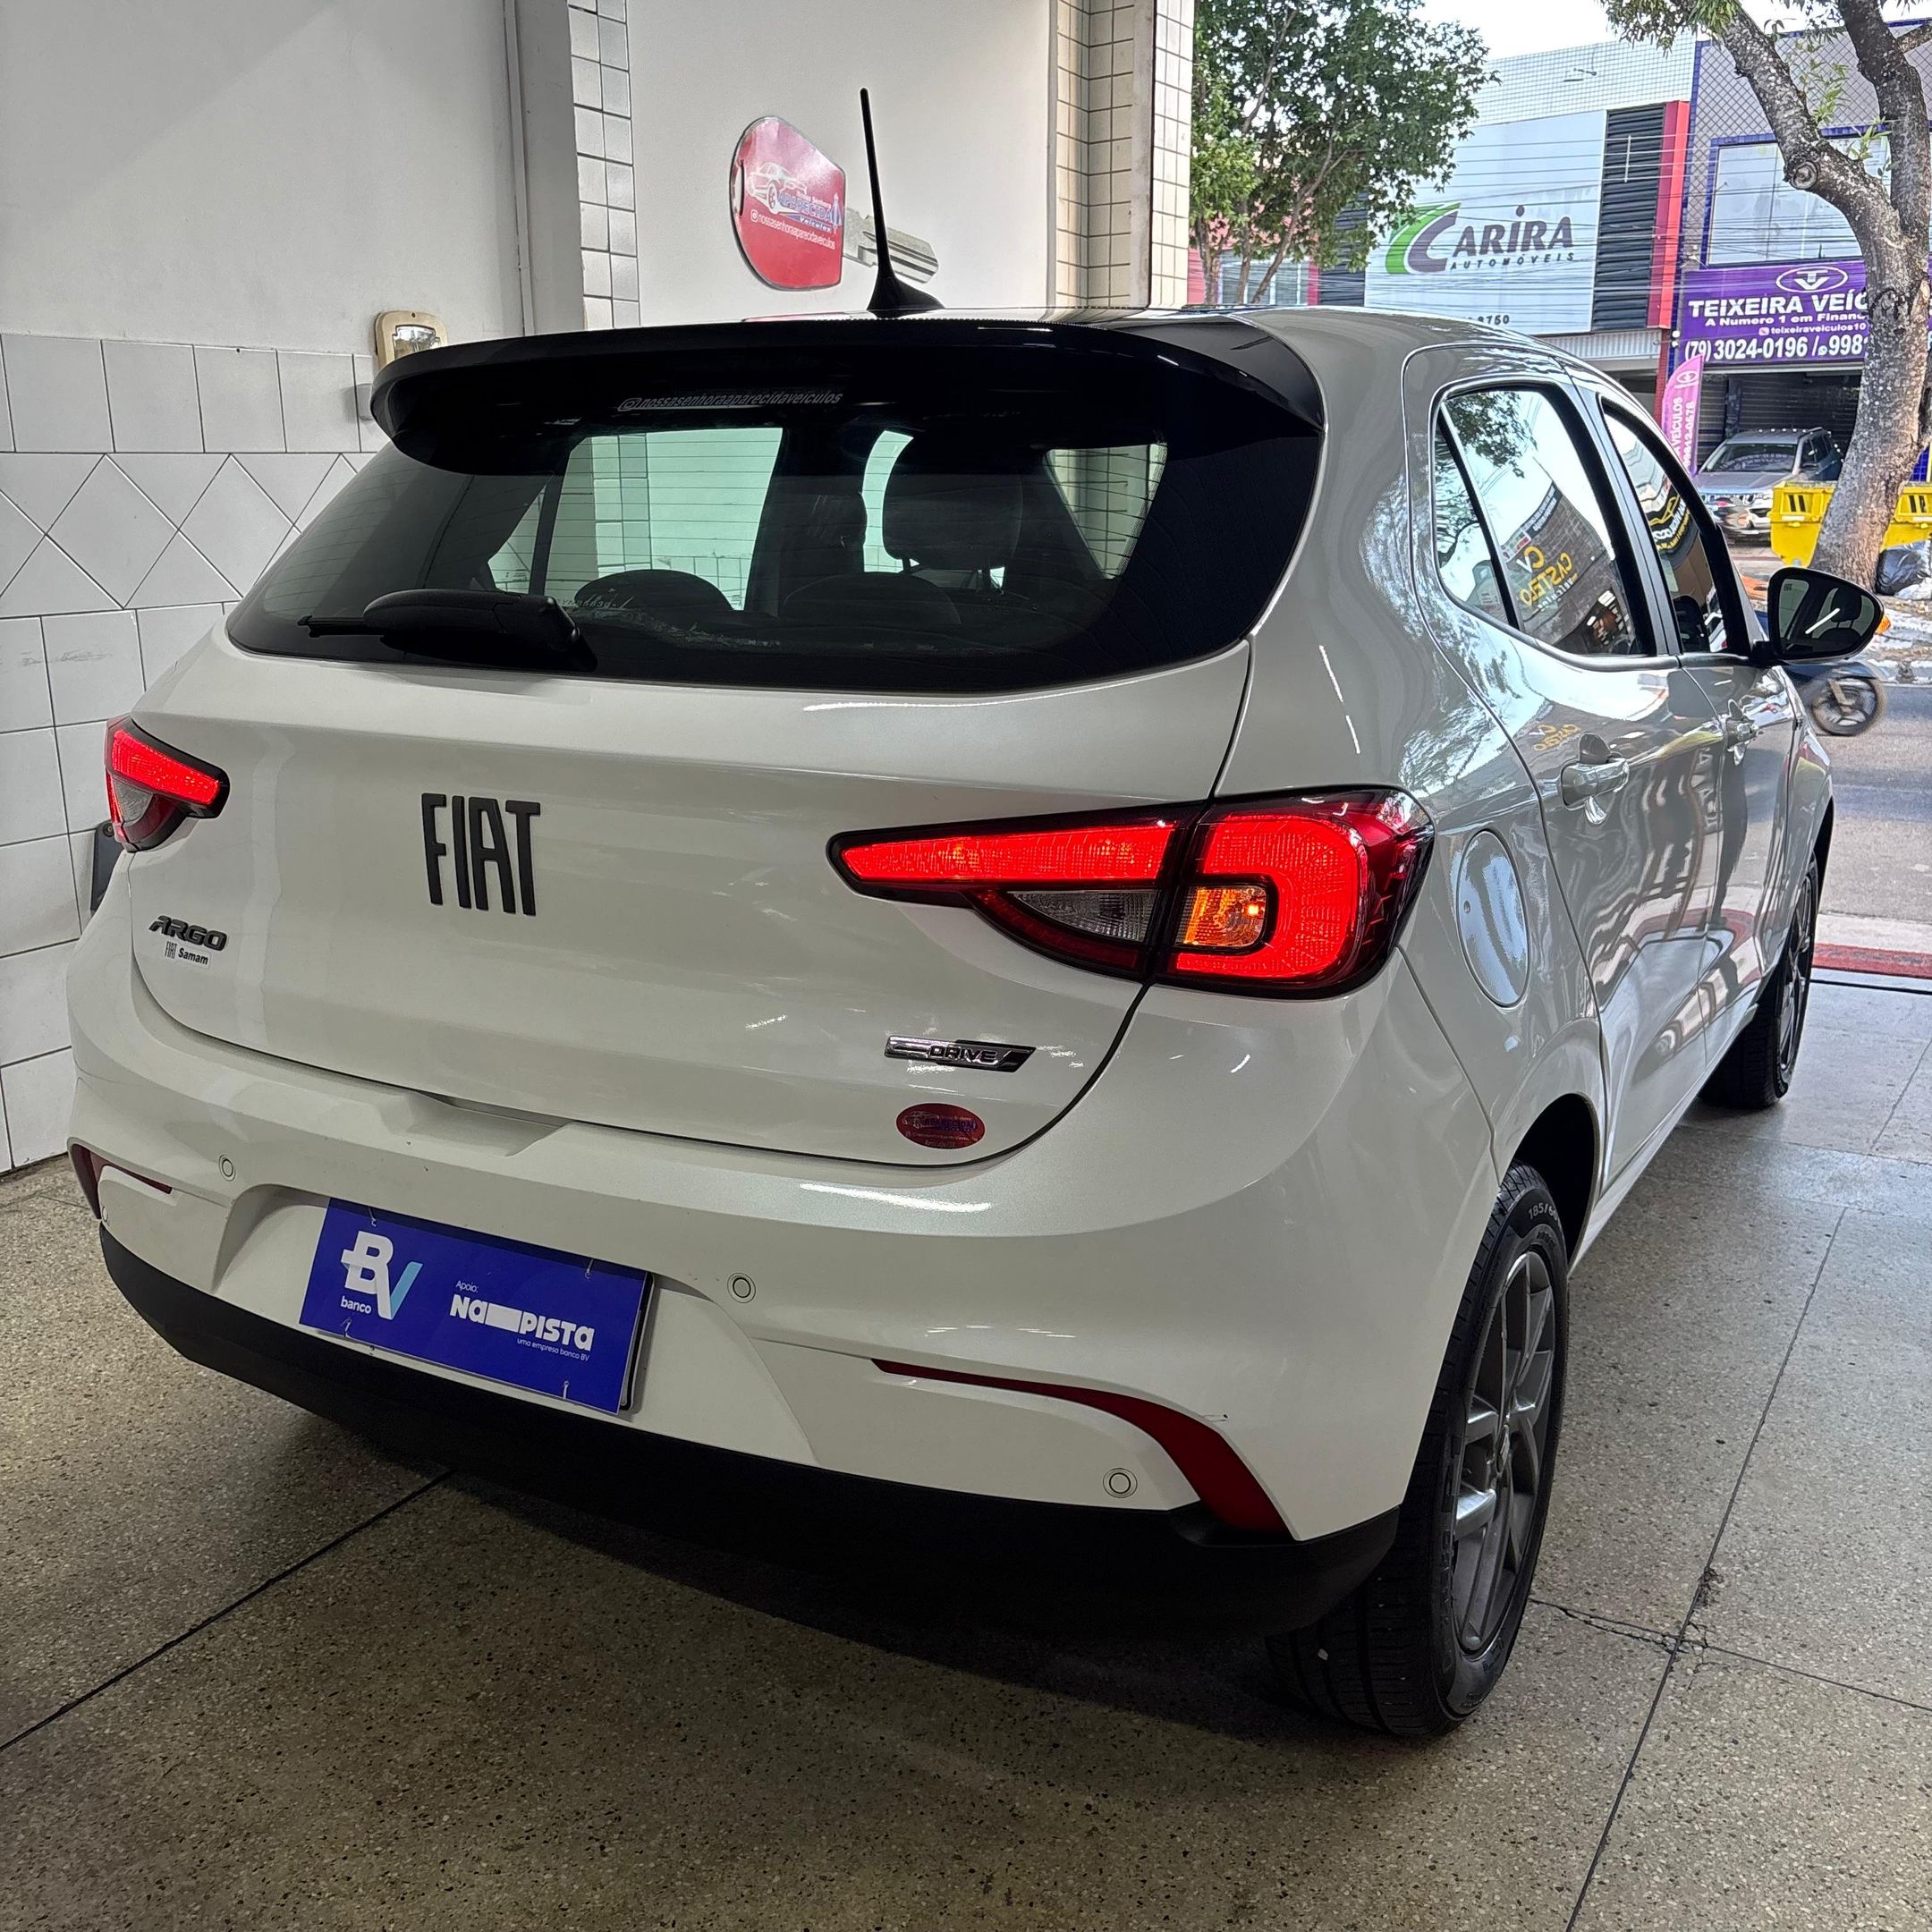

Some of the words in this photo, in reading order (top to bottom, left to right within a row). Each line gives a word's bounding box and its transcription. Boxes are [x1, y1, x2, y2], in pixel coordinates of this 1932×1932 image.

[1450, 252, 1575, 270] AUTOMÓVEIS
[1688, 296, 1804, 318] TEIXEIRA
[1705, 318, 1716, 327] A
[1778, 315, 1786, 324] 1
[421, 792, 541, 917] FIAT
[148, 915, 228, 952] ARGO
[178, 947, 209, 965] Samam
[929, 1045, 998, 1064] DRIVE
[455, 1280, 479, 1293] Apoio:
[340, 1295, 372, 1315] banco
[516, 1337, 531, 1347] uma
[531, 1343, 559, 1356] empresa
[559, 1347, 580, 1360] banco
[580, 1353, 590, 1362] BV
